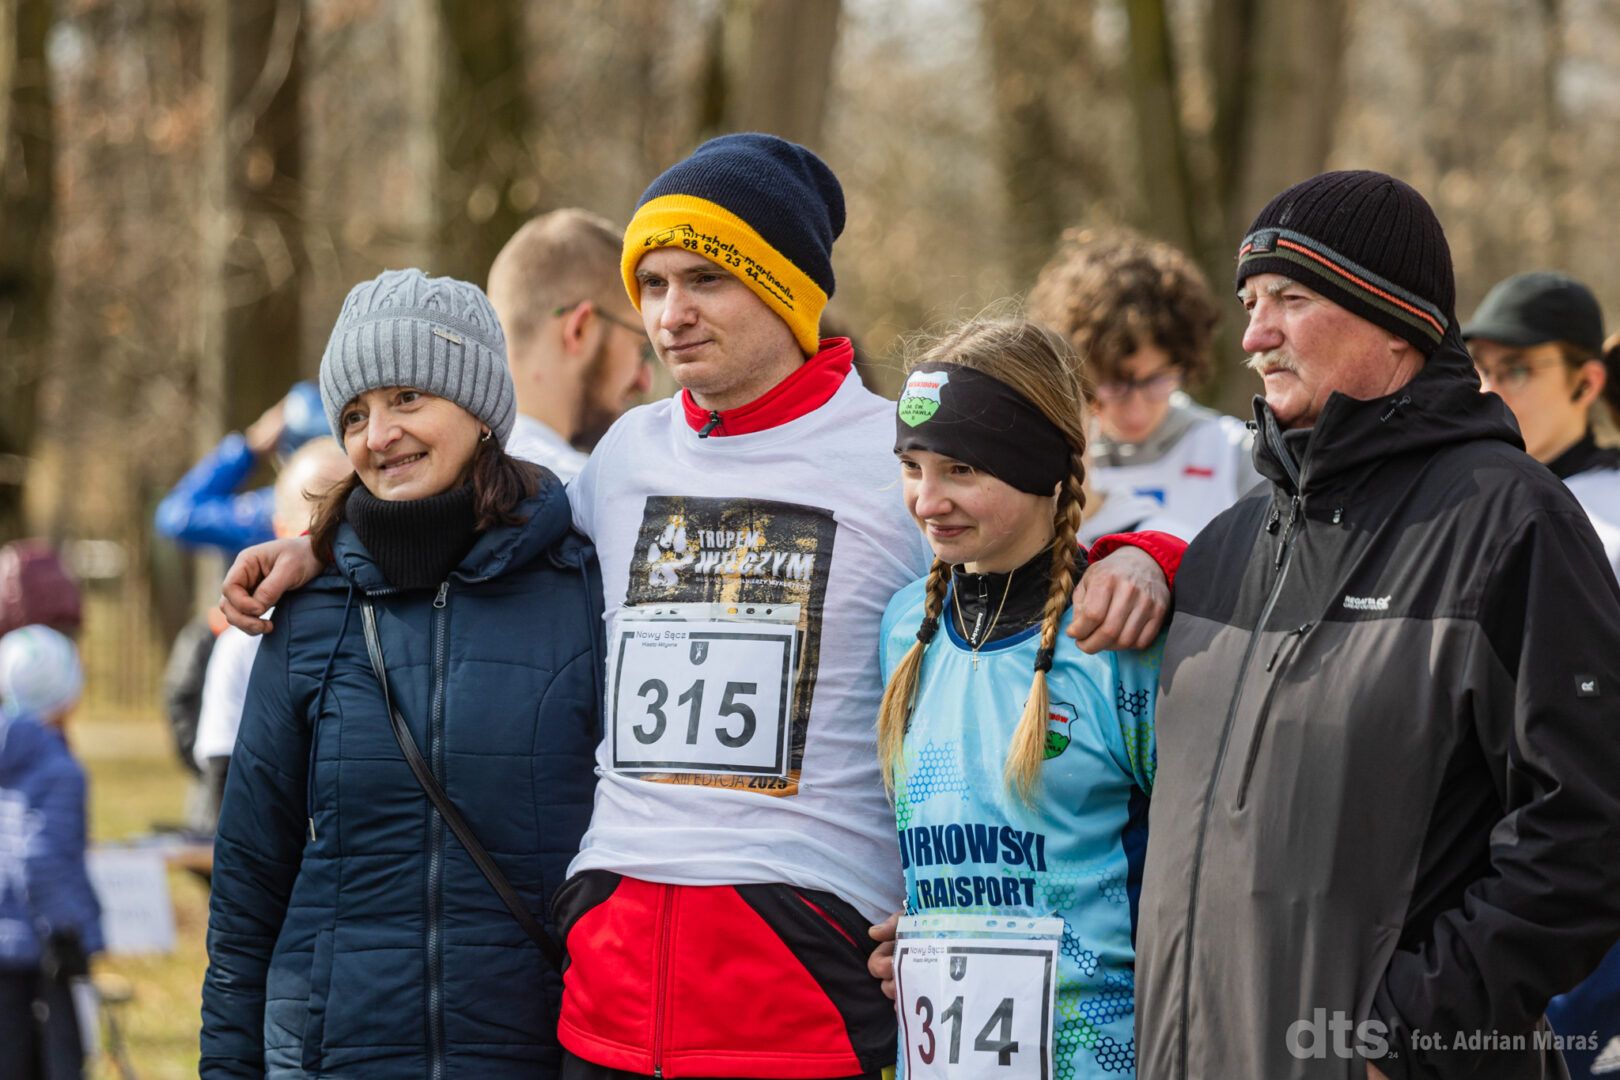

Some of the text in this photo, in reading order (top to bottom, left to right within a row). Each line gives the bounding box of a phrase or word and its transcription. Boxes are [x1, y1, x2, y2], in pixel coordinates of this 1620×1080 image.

[683, 239, 759, 281] 98 94 23 44
[698, 530, 759, 549] TROPEM
[695, 551, 814, 581] WILCZYM
[636, 631, 687, 640] Nowy Sącz
[632, 678, 757, 748] 315
[694, 774, 745, 788] EDYCJA
[748, 776, 788, 789] 2025
[915, 995, 1019, 1066] 314
